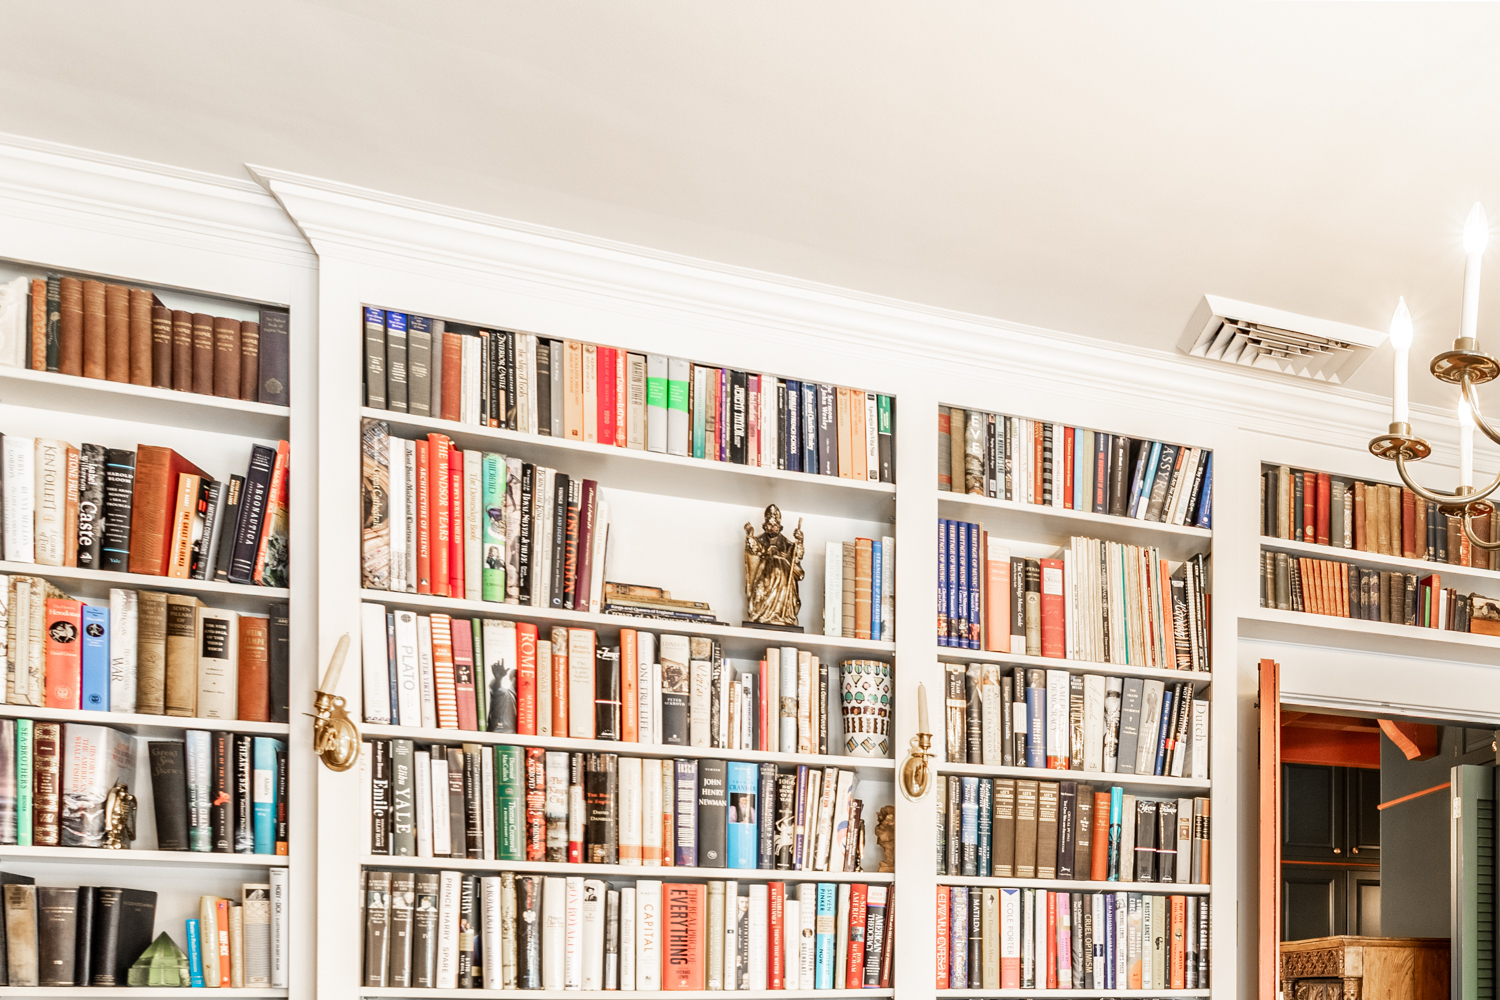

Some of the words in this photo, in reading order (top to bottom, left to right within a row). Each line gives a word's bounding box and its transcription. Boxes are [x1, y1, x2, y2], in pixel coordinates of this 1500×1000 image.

[497, 332, 506, 366] INTERIOR
[497, 366, 506, 390] CASTLE
[632, 362, 642, 382] MARTIN
[632, 384, 642, 406] LUTHER
[438, 440, 448, 458] THE
[970, 416, 981, 454] EVE
[44, 445, 57, 466] KEN
[68, 453, 78, 480] STONE
[372, 467, 381, 484] Great
[438, 463, 448, 506] WINDSOR
[488, 458, 497, 494] CHURCHILL
[1152, 445, 1174, 504] ASSYRIA
[67, 481, 78, 502] FRUIT
[372, 484, 383, 528] Cathedrals
[80, 501, 98, 546] Caste
[245, 482, 265, 545] ARGONAUTICA
[438, 510, 449, 542] YEARS
[566, 506, 579, 538] LOST
[178, 540, 188, 566] INFLUENZA
[420, 530, 428, 558] SILENCE
[564, 540, 578, 594] LONDON
[48, 608, 80, 618] Herodotus
[112, 658, 124, 682] WAR
[402, 645, 416, 690] PLATO
[521, 632, 534, 678] ROME
[640, 662, 648, 684] ONE
[422, 676, 430, 704] VIRTUE
[640, 686, 648, 709] TRUE
[526, 694, 534, 731] MATTHEW
[640, 710, 648, 732] LIFE
[1196, 703, 1206, 742] Dutch
[152, 748, 178, 758] Great
[72, 763, 80, 793] FISHERY
[398, 764, 408, 785] Elihu
[536, 762, 544, 784] PETER
[704, 778, 722, 786] JOHN
[372, 778, 388, 819] Emile
[698, 798, 728, 807] NEWMAN
[702, 788, 724, 796] HENRY
[396, 788, 411, 834] YALE
[508, 824, 516, 853] Cromwell
[444, 878, 452, 908] PRINCE
[462, 880, 472, 916] HARRY
[851, 891, 860, 925] AMERICA
[443, 910, 452, 942] HARRY
[644, 904, 654, 952] CAPITAL
[670, 889, 688, 966] EVERYTHING
[938, 894, 946, 934] EDWARD
[972, 898, 980, 932] MATILDA
[866, 913, 876, 952] THEOCRACY
[874, 913, 884, 954] AMERICAN
